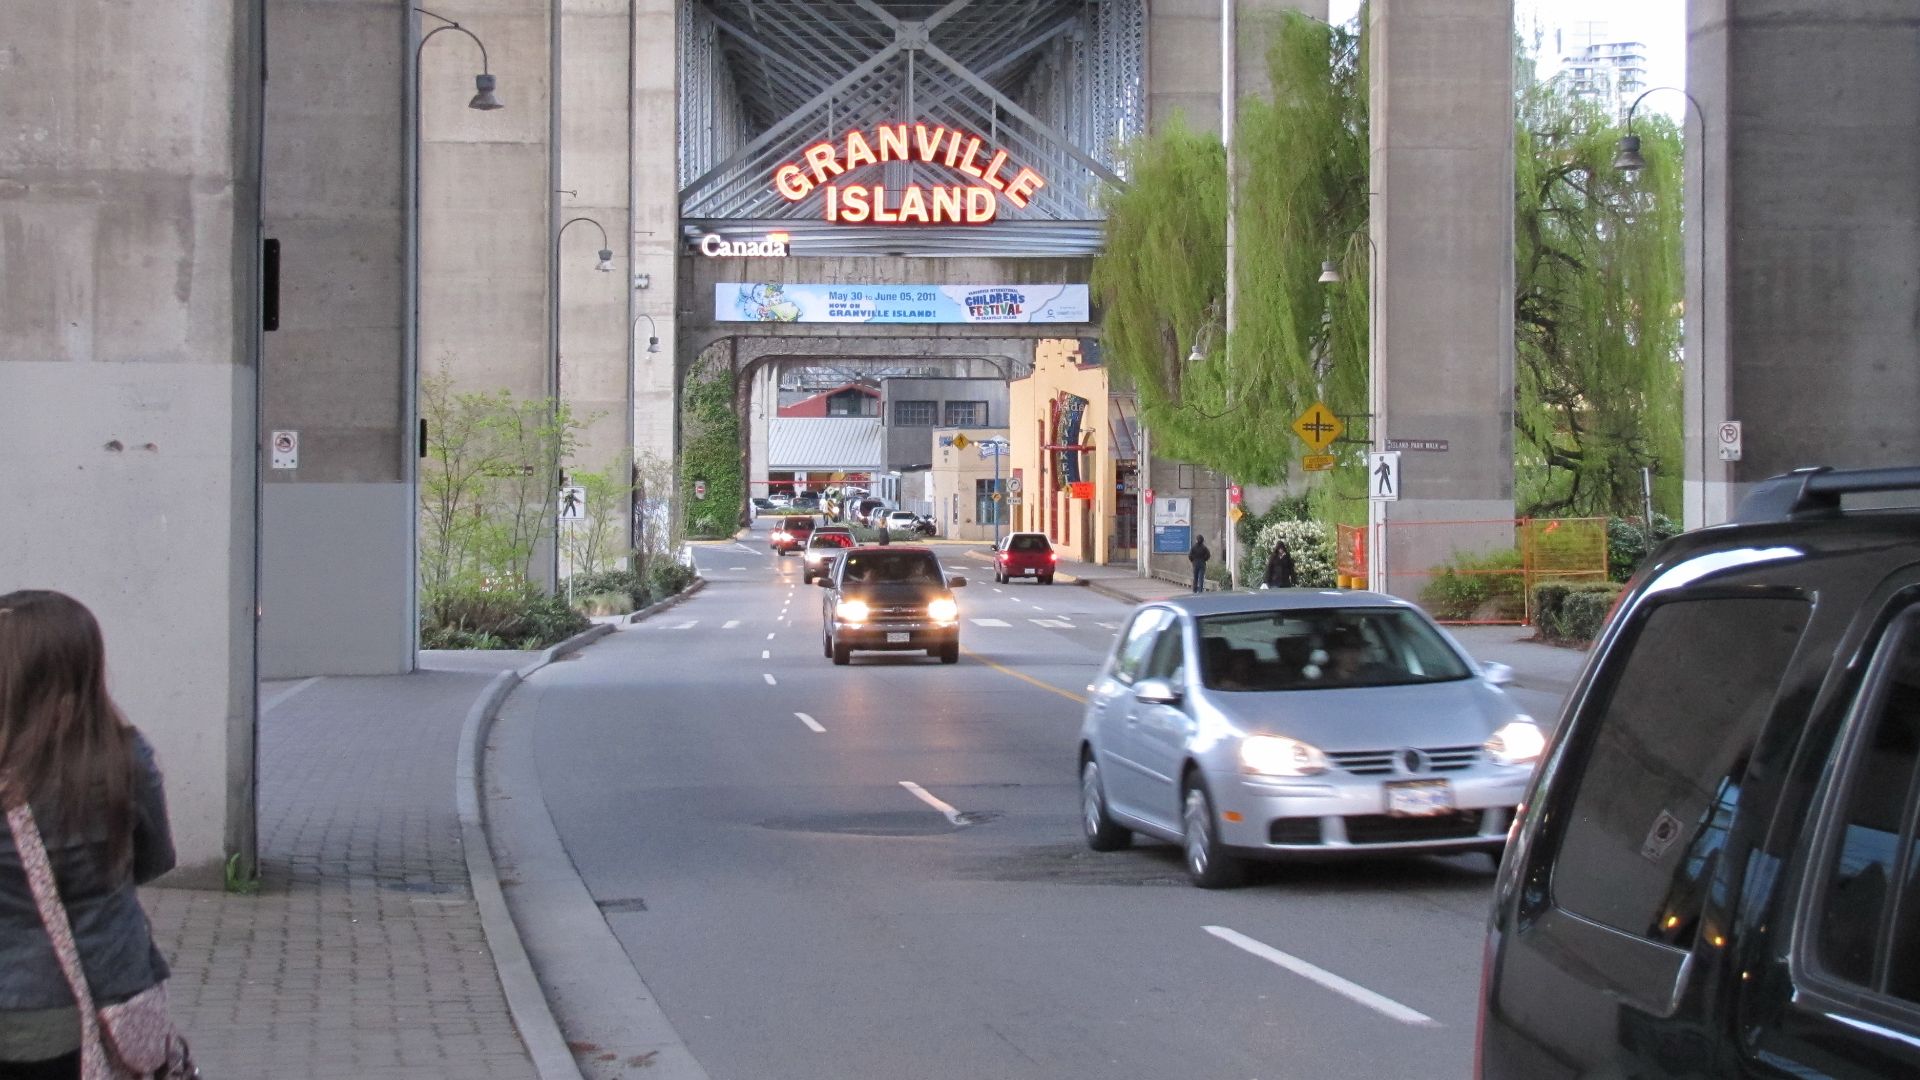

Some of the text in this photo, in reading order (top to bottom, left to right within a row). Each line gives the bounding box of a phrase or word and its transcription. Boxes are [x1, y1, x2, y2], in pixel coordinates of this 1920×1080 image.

[775, 124, 1045, 209] GRANVILLE
[826, 185, 997, 223] ISLAND
[702, 234, 788, 257] Canada
[829, 291, 848, 302] May
[850, 291, 863, 301] 30
[875, 292, 897, 301] June
[900, 292, 914, 302] 05,
[917, 292, 936, 301] 2011
[969, 302, 1022, 316] FESTIVAL
